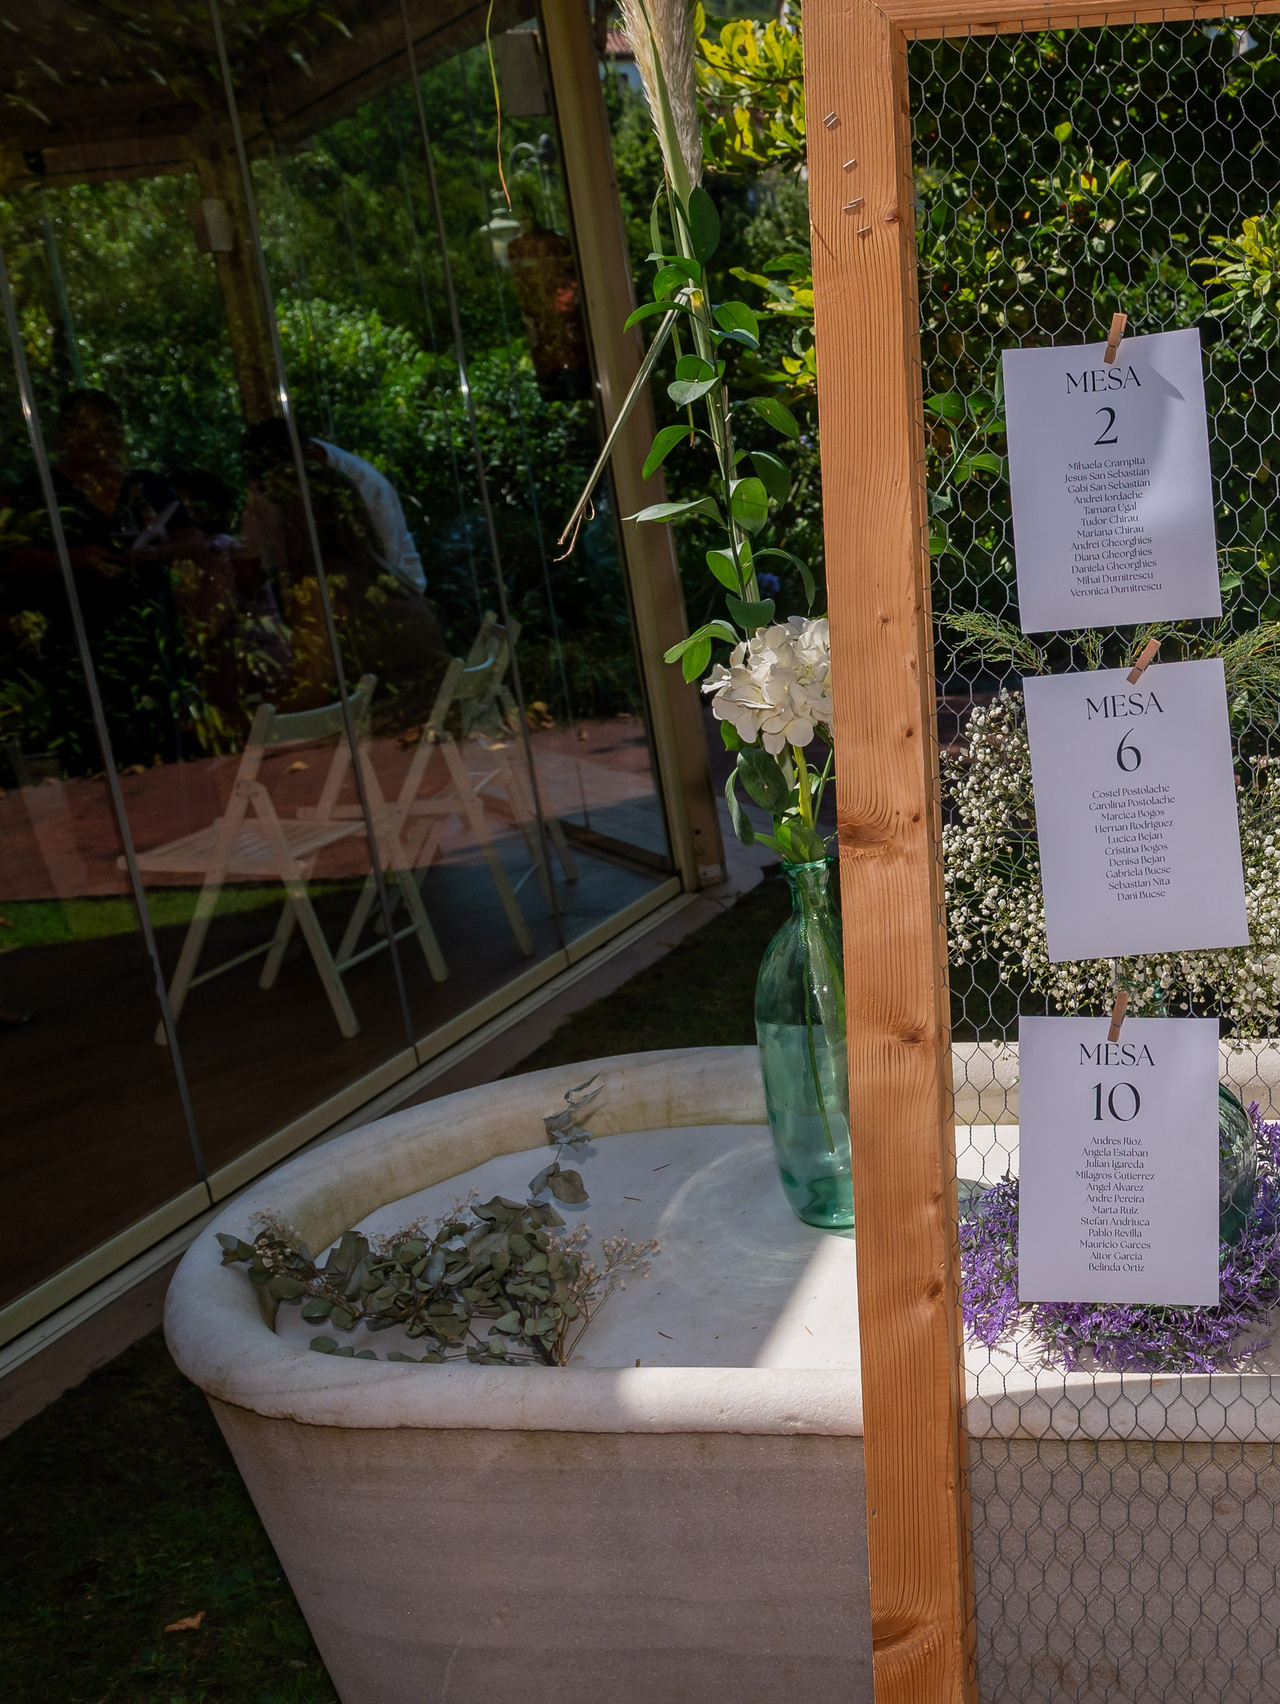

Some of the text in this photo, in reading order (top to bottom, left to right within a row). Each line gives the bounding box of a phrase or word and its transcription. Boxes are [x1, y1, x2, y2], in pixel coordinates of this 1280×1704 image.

[1065, 365, 1142, 395] MESA
[1093, 406, 1119, 446] 2
[1073, 489, 1143, 504] Andrei Iordache
[1080, 512, 1138, 526] Tudor Chirau
[1070, 534, 1152, 550] Andrei Gheorghies
[1071, 557, 1157, 573] Daniela Gheorghies
[1070, 580, 1161, 597] Veronica Dumitrescu
[1085, 691, 1165, 720] MESA
[1116, 727, 1142, 772] 6
[1091, 783, 1169, 799] Costel Postolache
[1088, 794, 1175, 810] Carolina Postolache
[1101, 806, 1165, 821] Marcica Bogos
[1104, 841, 1168, 855] Cristina Bogos
[1108, 853, 1165, 866] Denisa Bejan
[1079, 1042, 1156, 1067] MESA
[1091, 1081, 1142, 1122] 10
[1081, 1147, 1148, 1159] Angela Estaban
[1085, 1193, 1144, 1203] Andre Pereira
[1092, 1204, 1138, 1214] Marta Ruiz
[1088, 1227, 1142, 1237] Pablo Revilla
[1088, 1261, 1144, 1271] Belinda Ortiz
